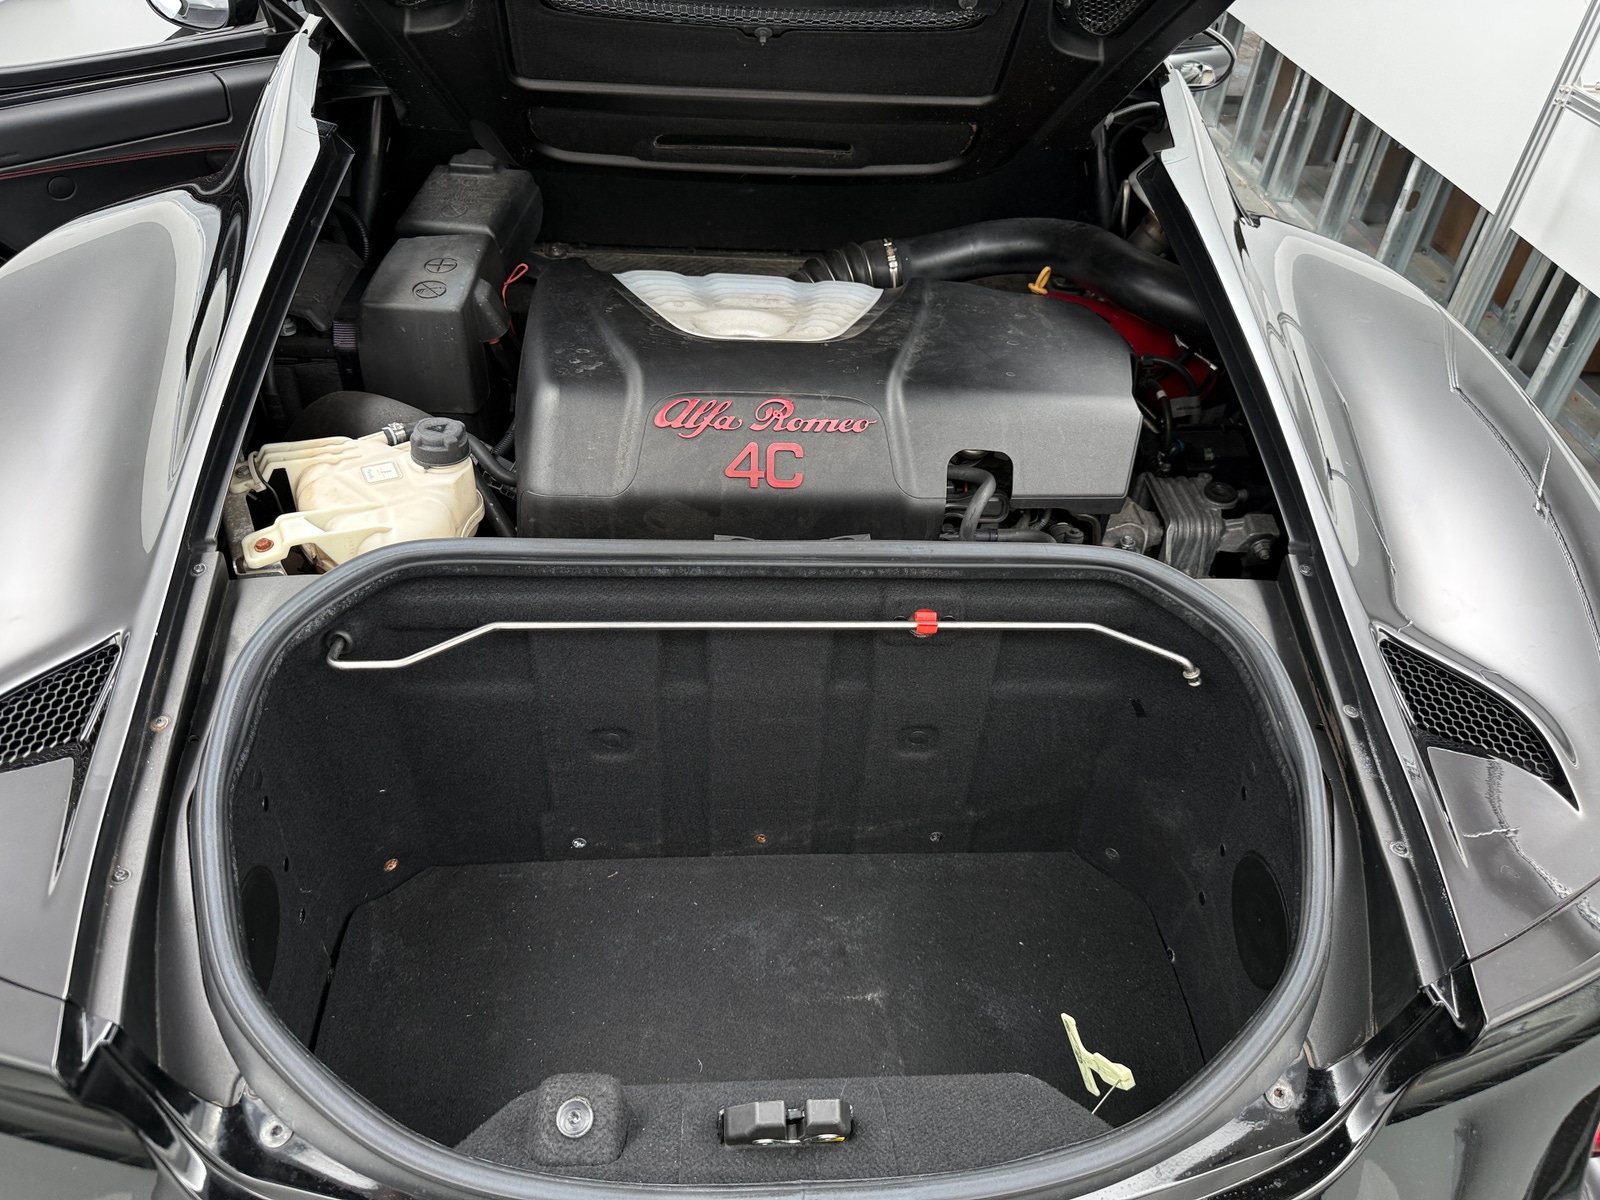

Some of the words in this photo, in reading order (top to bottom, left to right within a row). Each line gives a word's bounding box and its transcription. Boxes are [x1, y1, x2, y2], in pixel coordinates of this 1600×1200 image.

[654, 397, 743, 439] Alfa
[750, 397, 878, 434] Romeo
[724, 441, 804, 489] 4C
